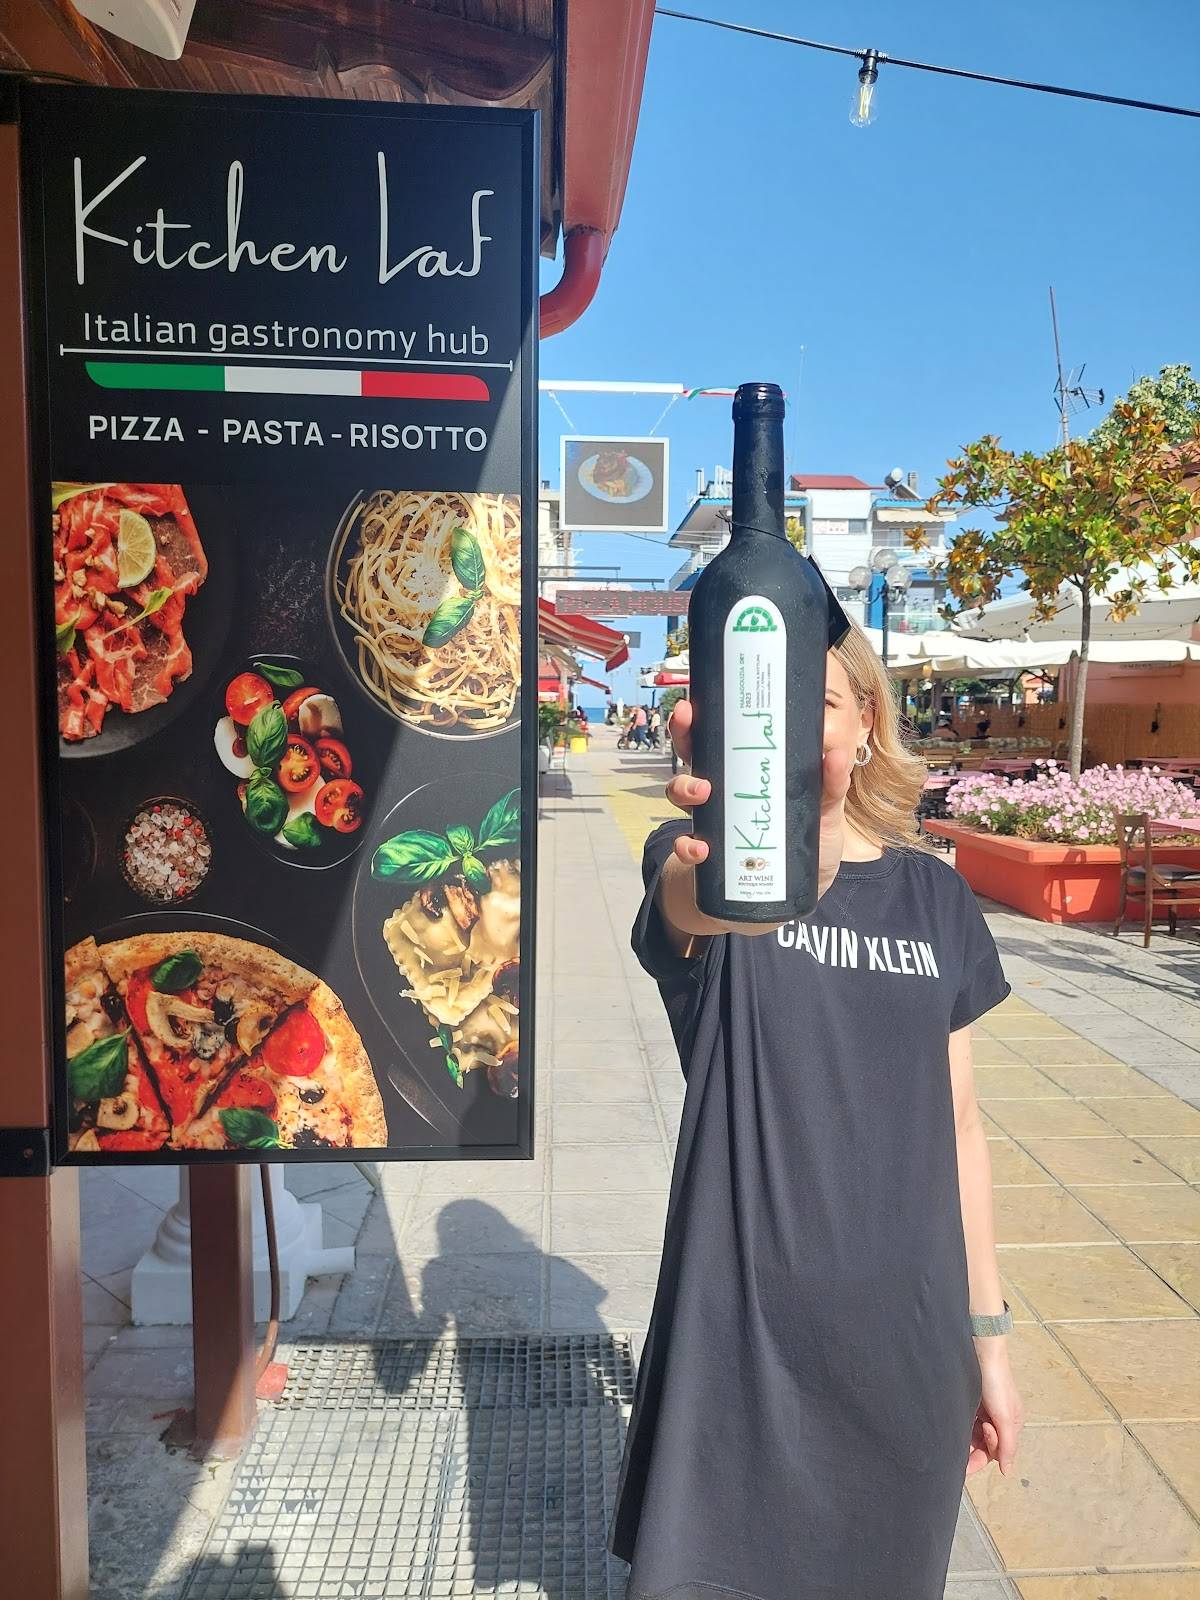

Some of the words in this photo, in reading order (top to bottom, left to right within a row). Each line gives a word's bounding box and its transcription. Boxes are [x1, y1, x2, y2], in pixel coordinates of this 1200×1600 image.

[74, 155, 347, 286] Kitchen
[83, 312, 197, 344] Italian
[208, 318, 417, 359] gastronomy
[428, 323, 490, 356] hub
[88, 415, 184, 442] PIZZA
[222, 418, 324, 447] PASTA
[349, 423, 488, 452] RISOTTO
[628, 596, 690, 613] HOUS
[733, 757, 777, 851] Kitchen
